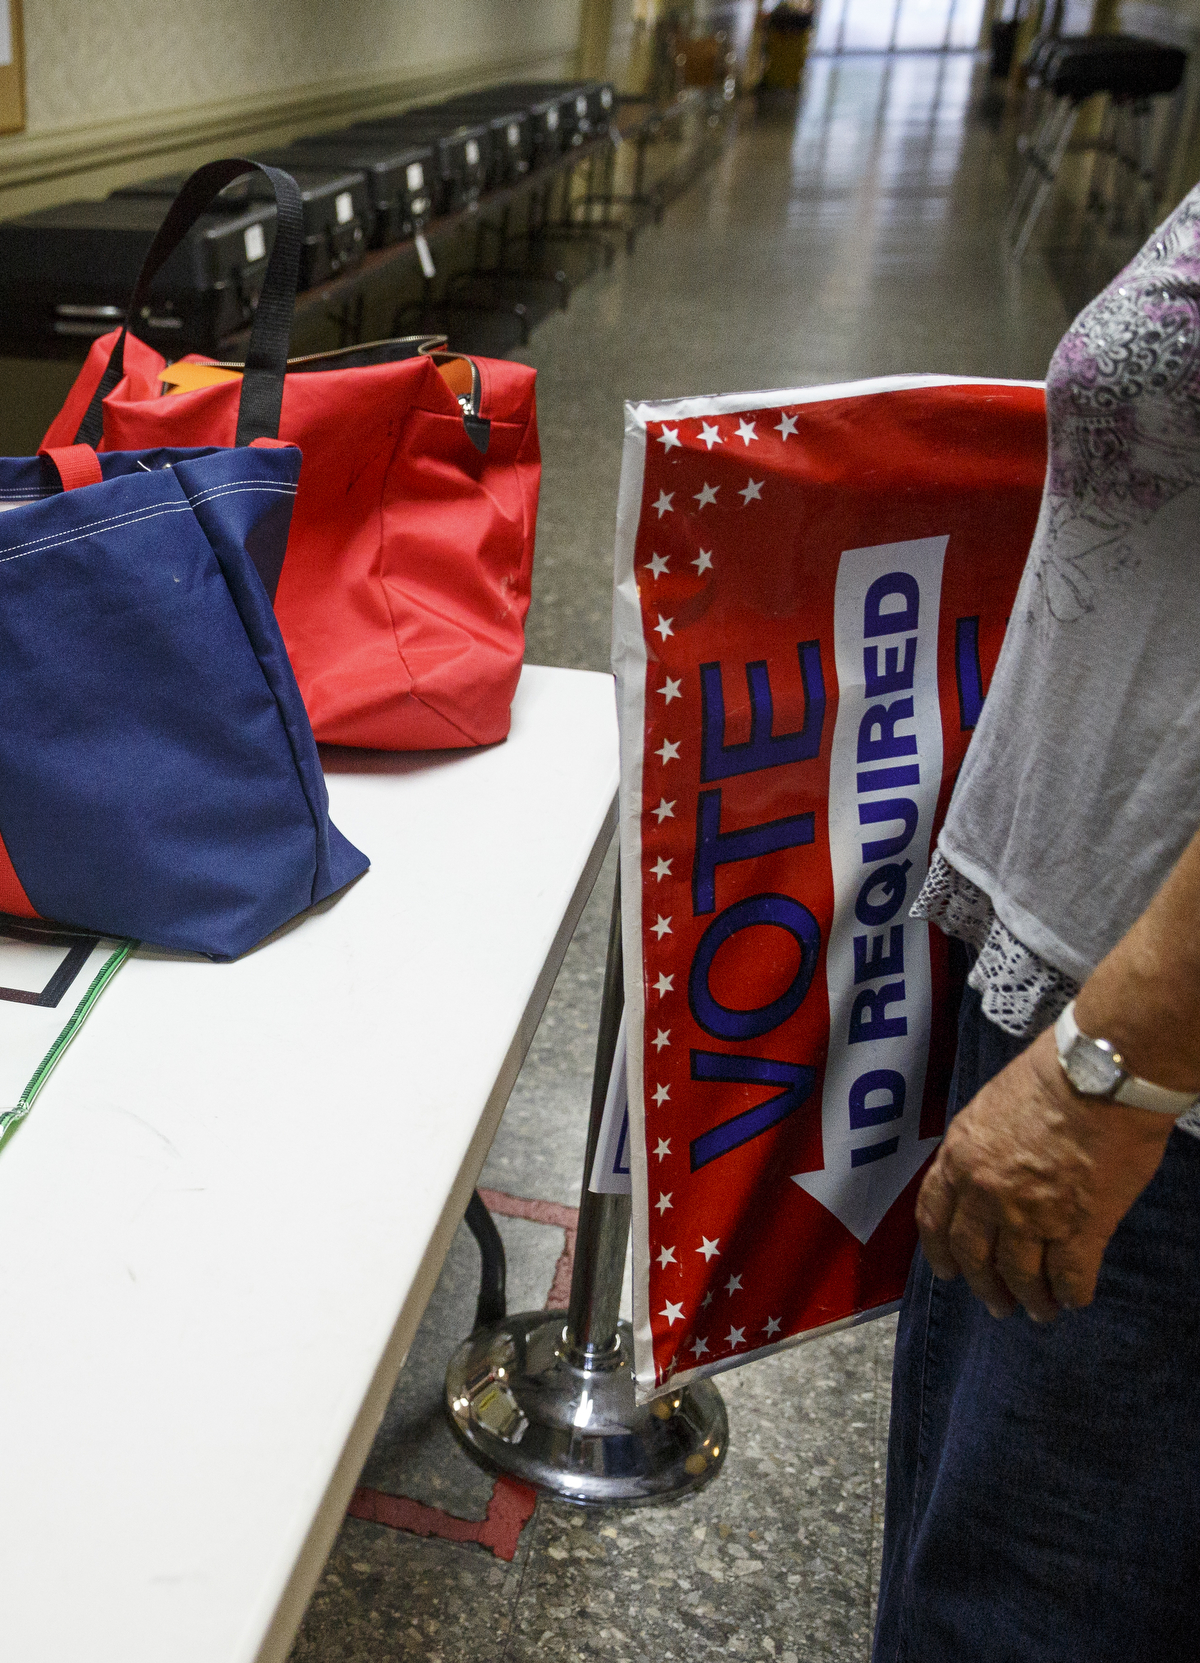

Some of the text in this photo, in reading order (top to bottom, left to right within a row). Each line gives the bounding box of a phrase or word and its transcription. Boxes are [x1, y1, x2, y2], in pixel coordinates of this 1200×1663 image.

[687, 639, 826, 1172] VOTE
[849, 571, 920, 1169] ID REQUIRED
